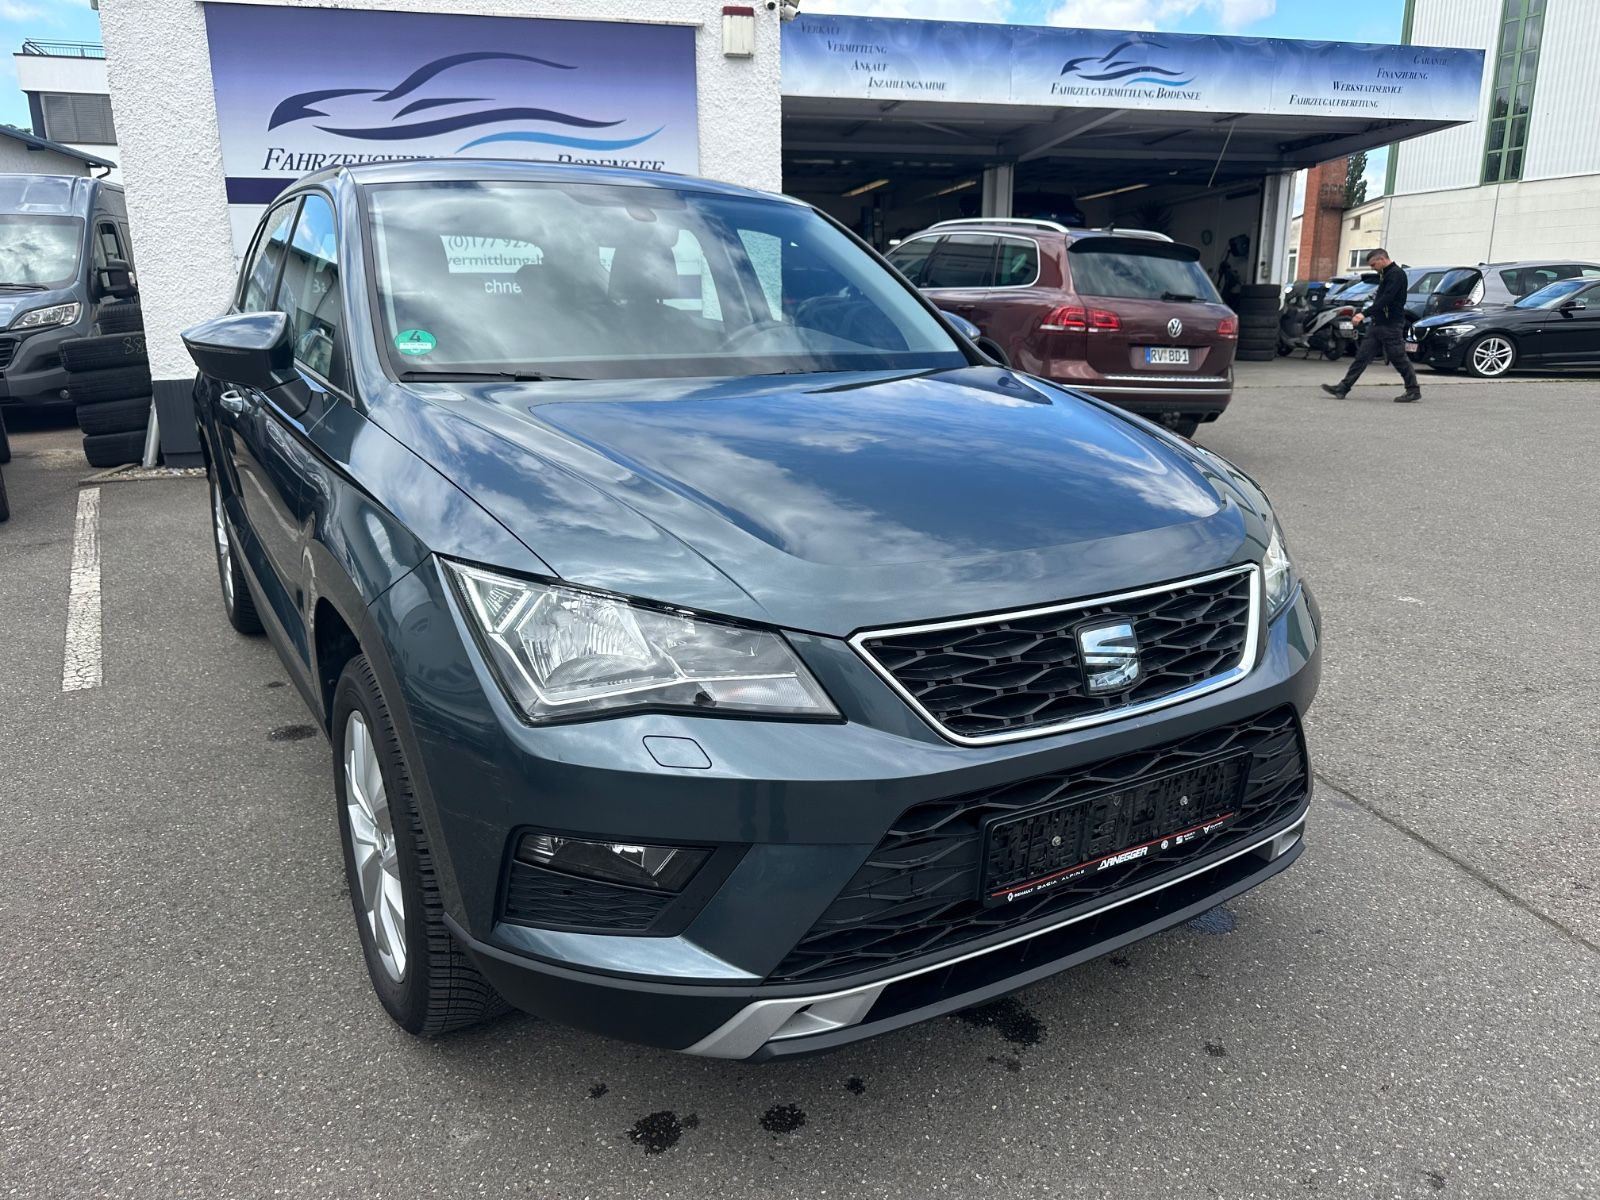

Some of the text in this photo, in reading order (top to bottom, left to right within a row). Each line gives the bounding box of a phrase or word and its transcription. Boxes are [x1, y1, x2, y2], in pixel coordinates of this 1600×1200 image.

[826, 40, 887, 54] VERMITTLUNG
[851, 60, 889, 72] ANKAUF
[1376, 68, 1429, 80] FINANZIERUNG
[868, 76, 948, 91] INZAHLUNGNAHME
[1333, 80, 1404, 94] WERKSTATTSERVICE
[1051, 82, 1201, 101] FAHRZEUGVERMITTLUNG BODENSEE
[1289, 94, 1379, 108] FAHRZEUGAUFBEREITUNG
[409, 331, 422, 342] 4
[1061, 869, 1085, 881] ALPINE
[1097, 846, 1149, 870] ARNEGGER
